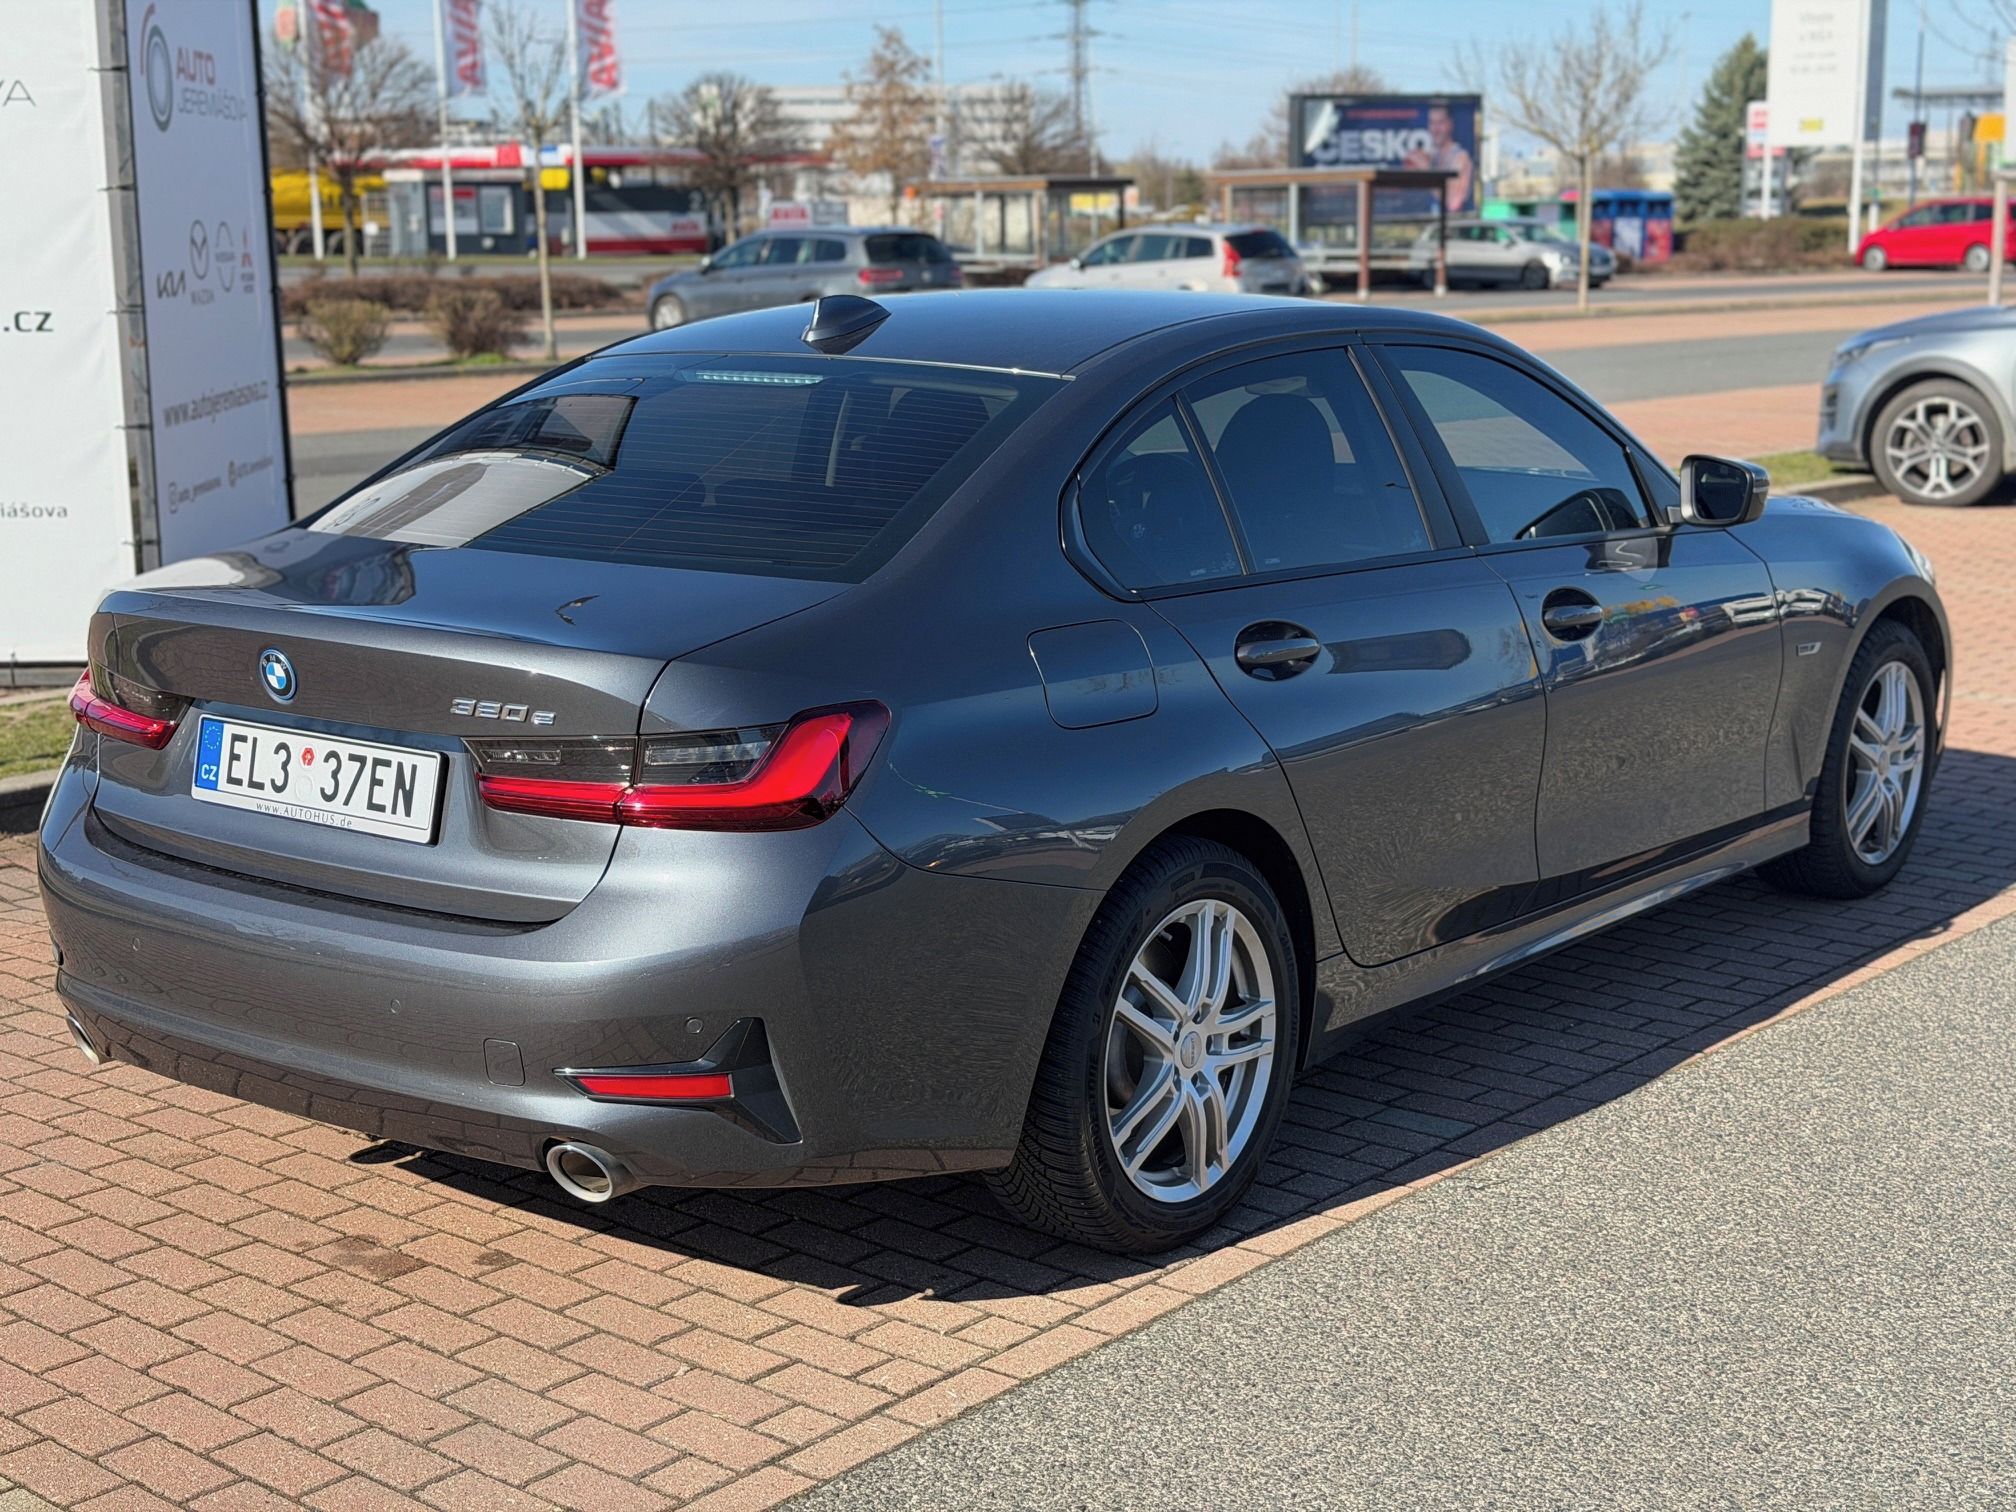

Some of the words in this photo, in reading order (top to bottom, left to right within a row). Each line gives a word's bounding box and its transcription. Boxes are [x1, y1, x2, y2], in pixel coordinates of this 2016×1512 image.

[176, 47, 215, 86] AUTO
[0, 79, 37, 107] A
[3, 311, 54, 332] .cz
[201, 763, 217, 781] CZ
[226, 733, 292, 793] EL3
[319, 750, 417, 818] 37EN
[256, 802, 352, 827] www.AUTOHUS.de
